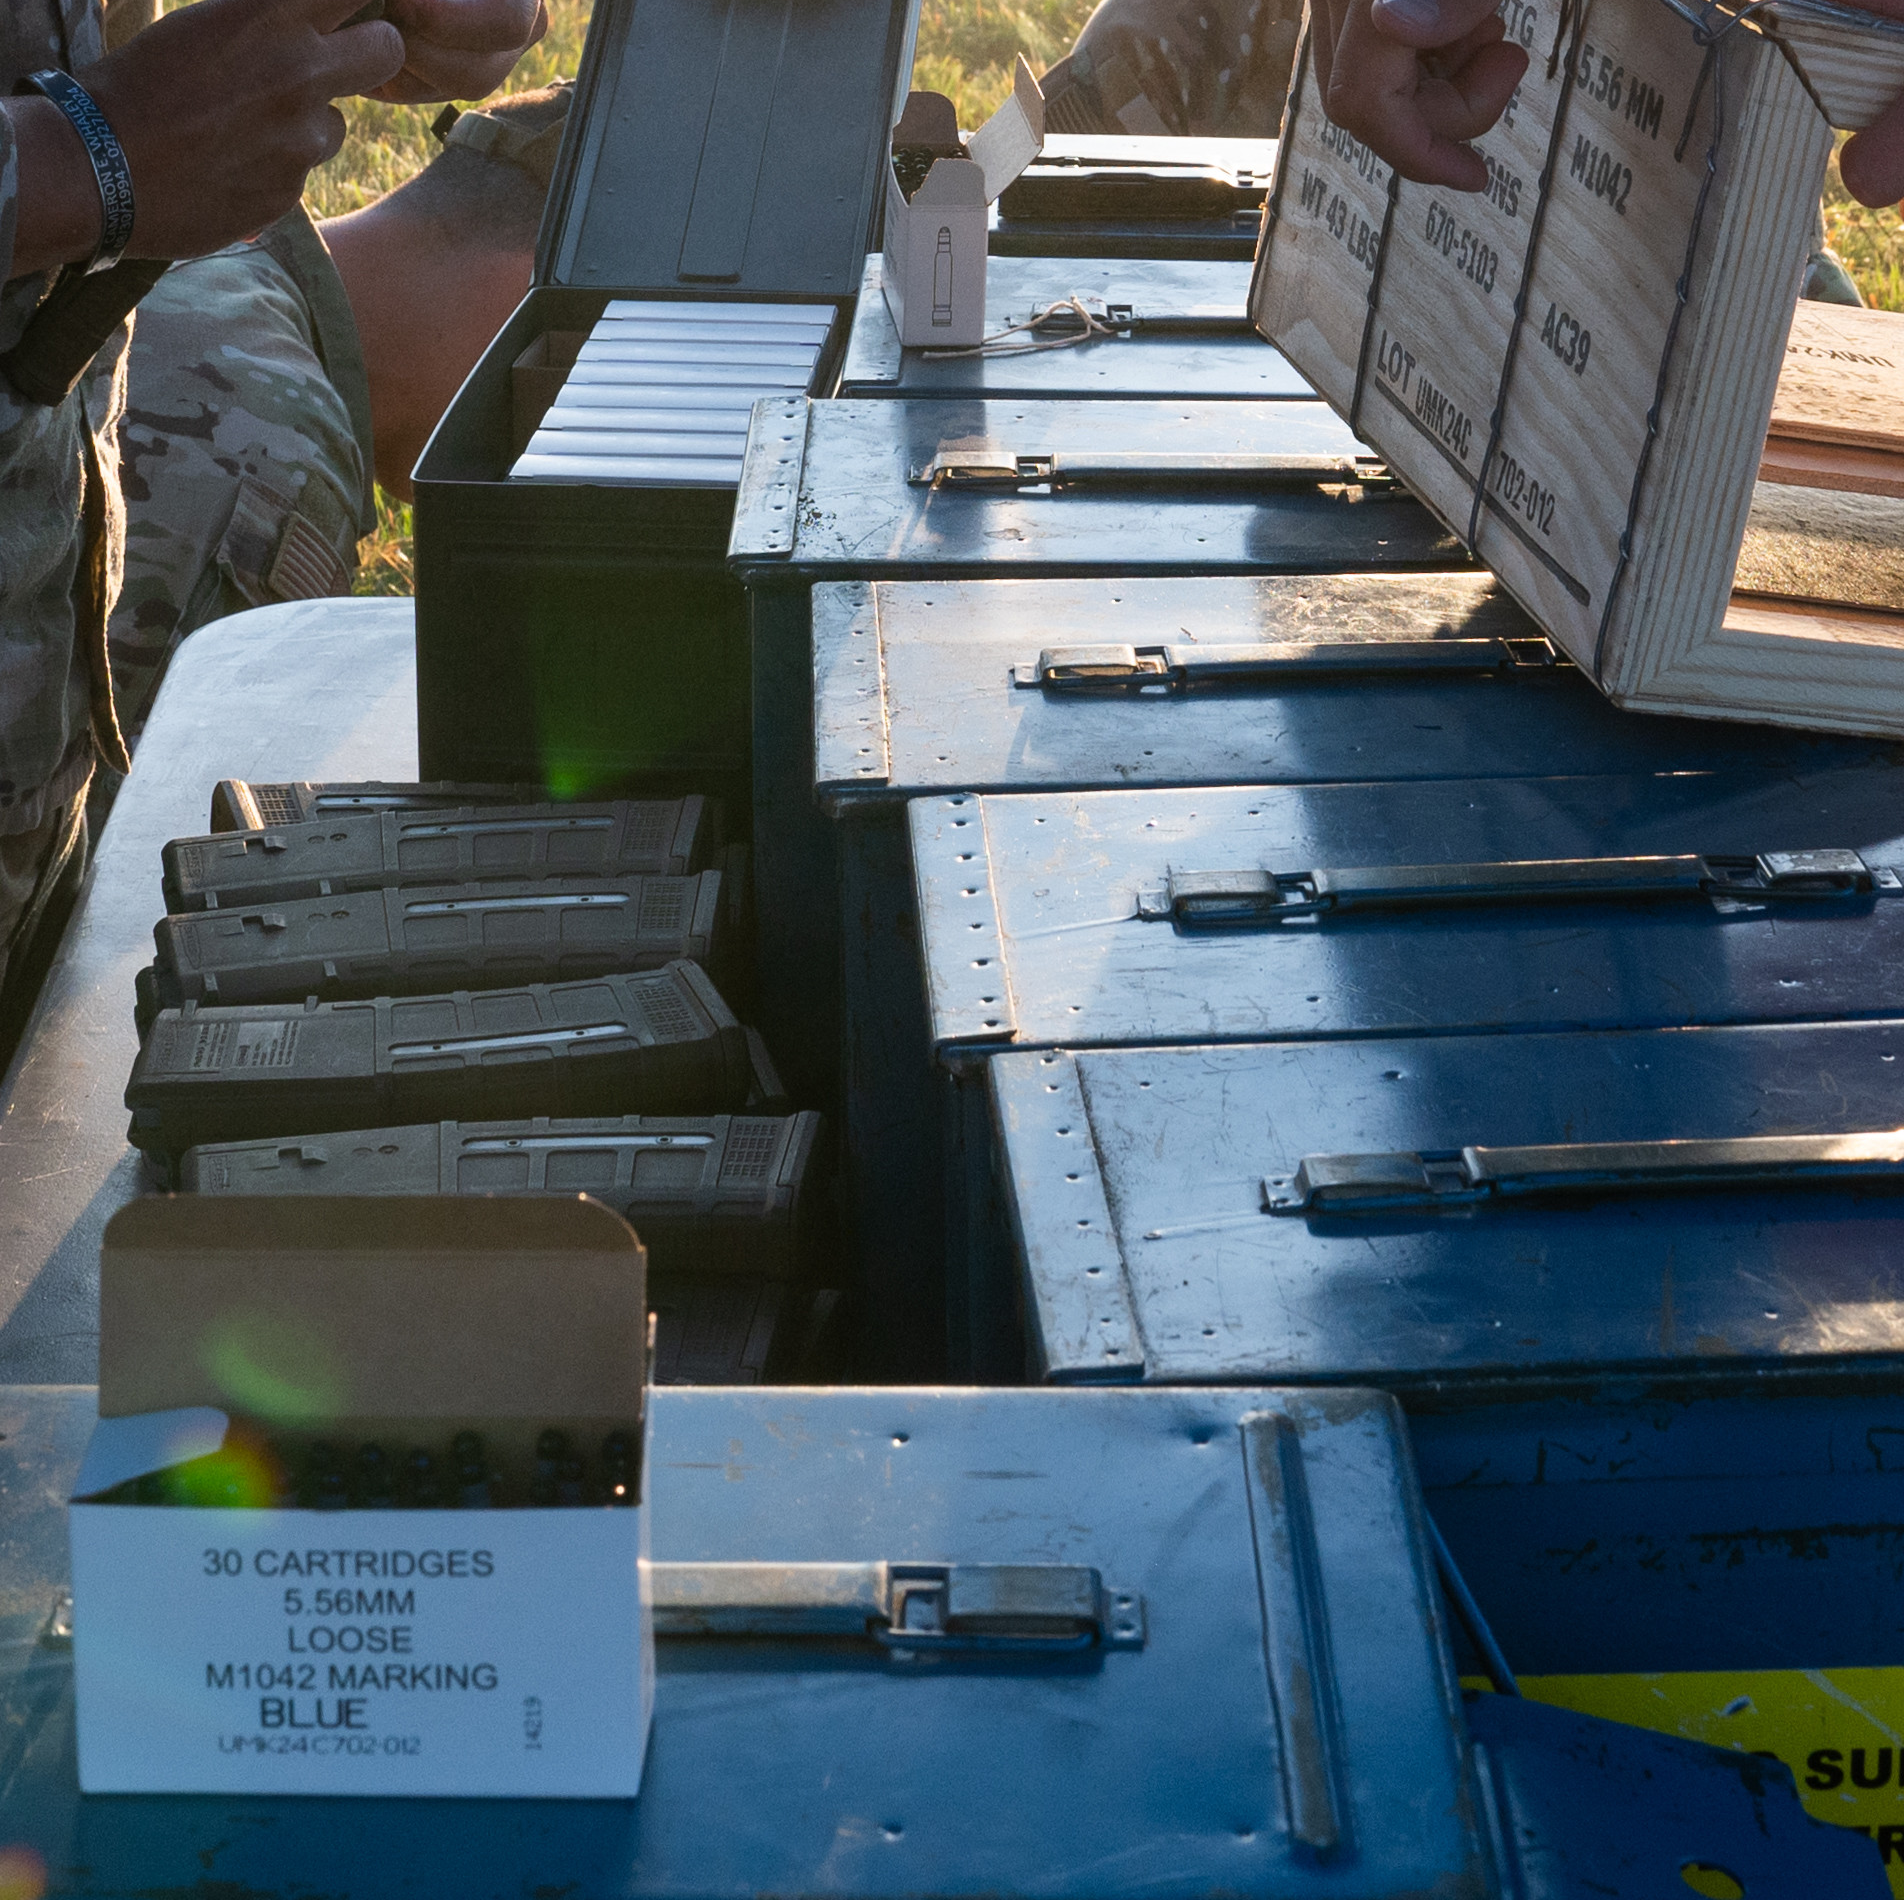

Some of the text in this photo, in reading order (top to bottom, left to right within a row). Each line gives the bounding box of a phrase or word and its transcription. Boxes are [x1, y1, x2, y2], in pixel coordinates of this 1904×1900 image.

[61, 98, 102, 152] WHALEY
[66, 86, 120, 158] 02/27/2024
[1577, 43, 1621, 112] 5.56
[1624, 76, 1664, 141] MM
[100, 170, 120, 245] CAMERON
[1570, 133, 1633, 216] M1042
[1301, 167, 1381, 272] WT 43 LBS
[1425, 200, 1498, 294] 670-5103
[1541, 302, 1592, 377] AC39
[1377, 329, 1556, 537] LOT UMK24C 702-012
[202, 1548, 495, 1579] 30 CARTRIDGES
[283, 1587, 416, 1616] 5.56MM
[288, 1625, 414, 1654] LOOSE
[205, 1663, 499, 1691] M1042 MARKING
[259, 1697, 369, 1730] BLUE
